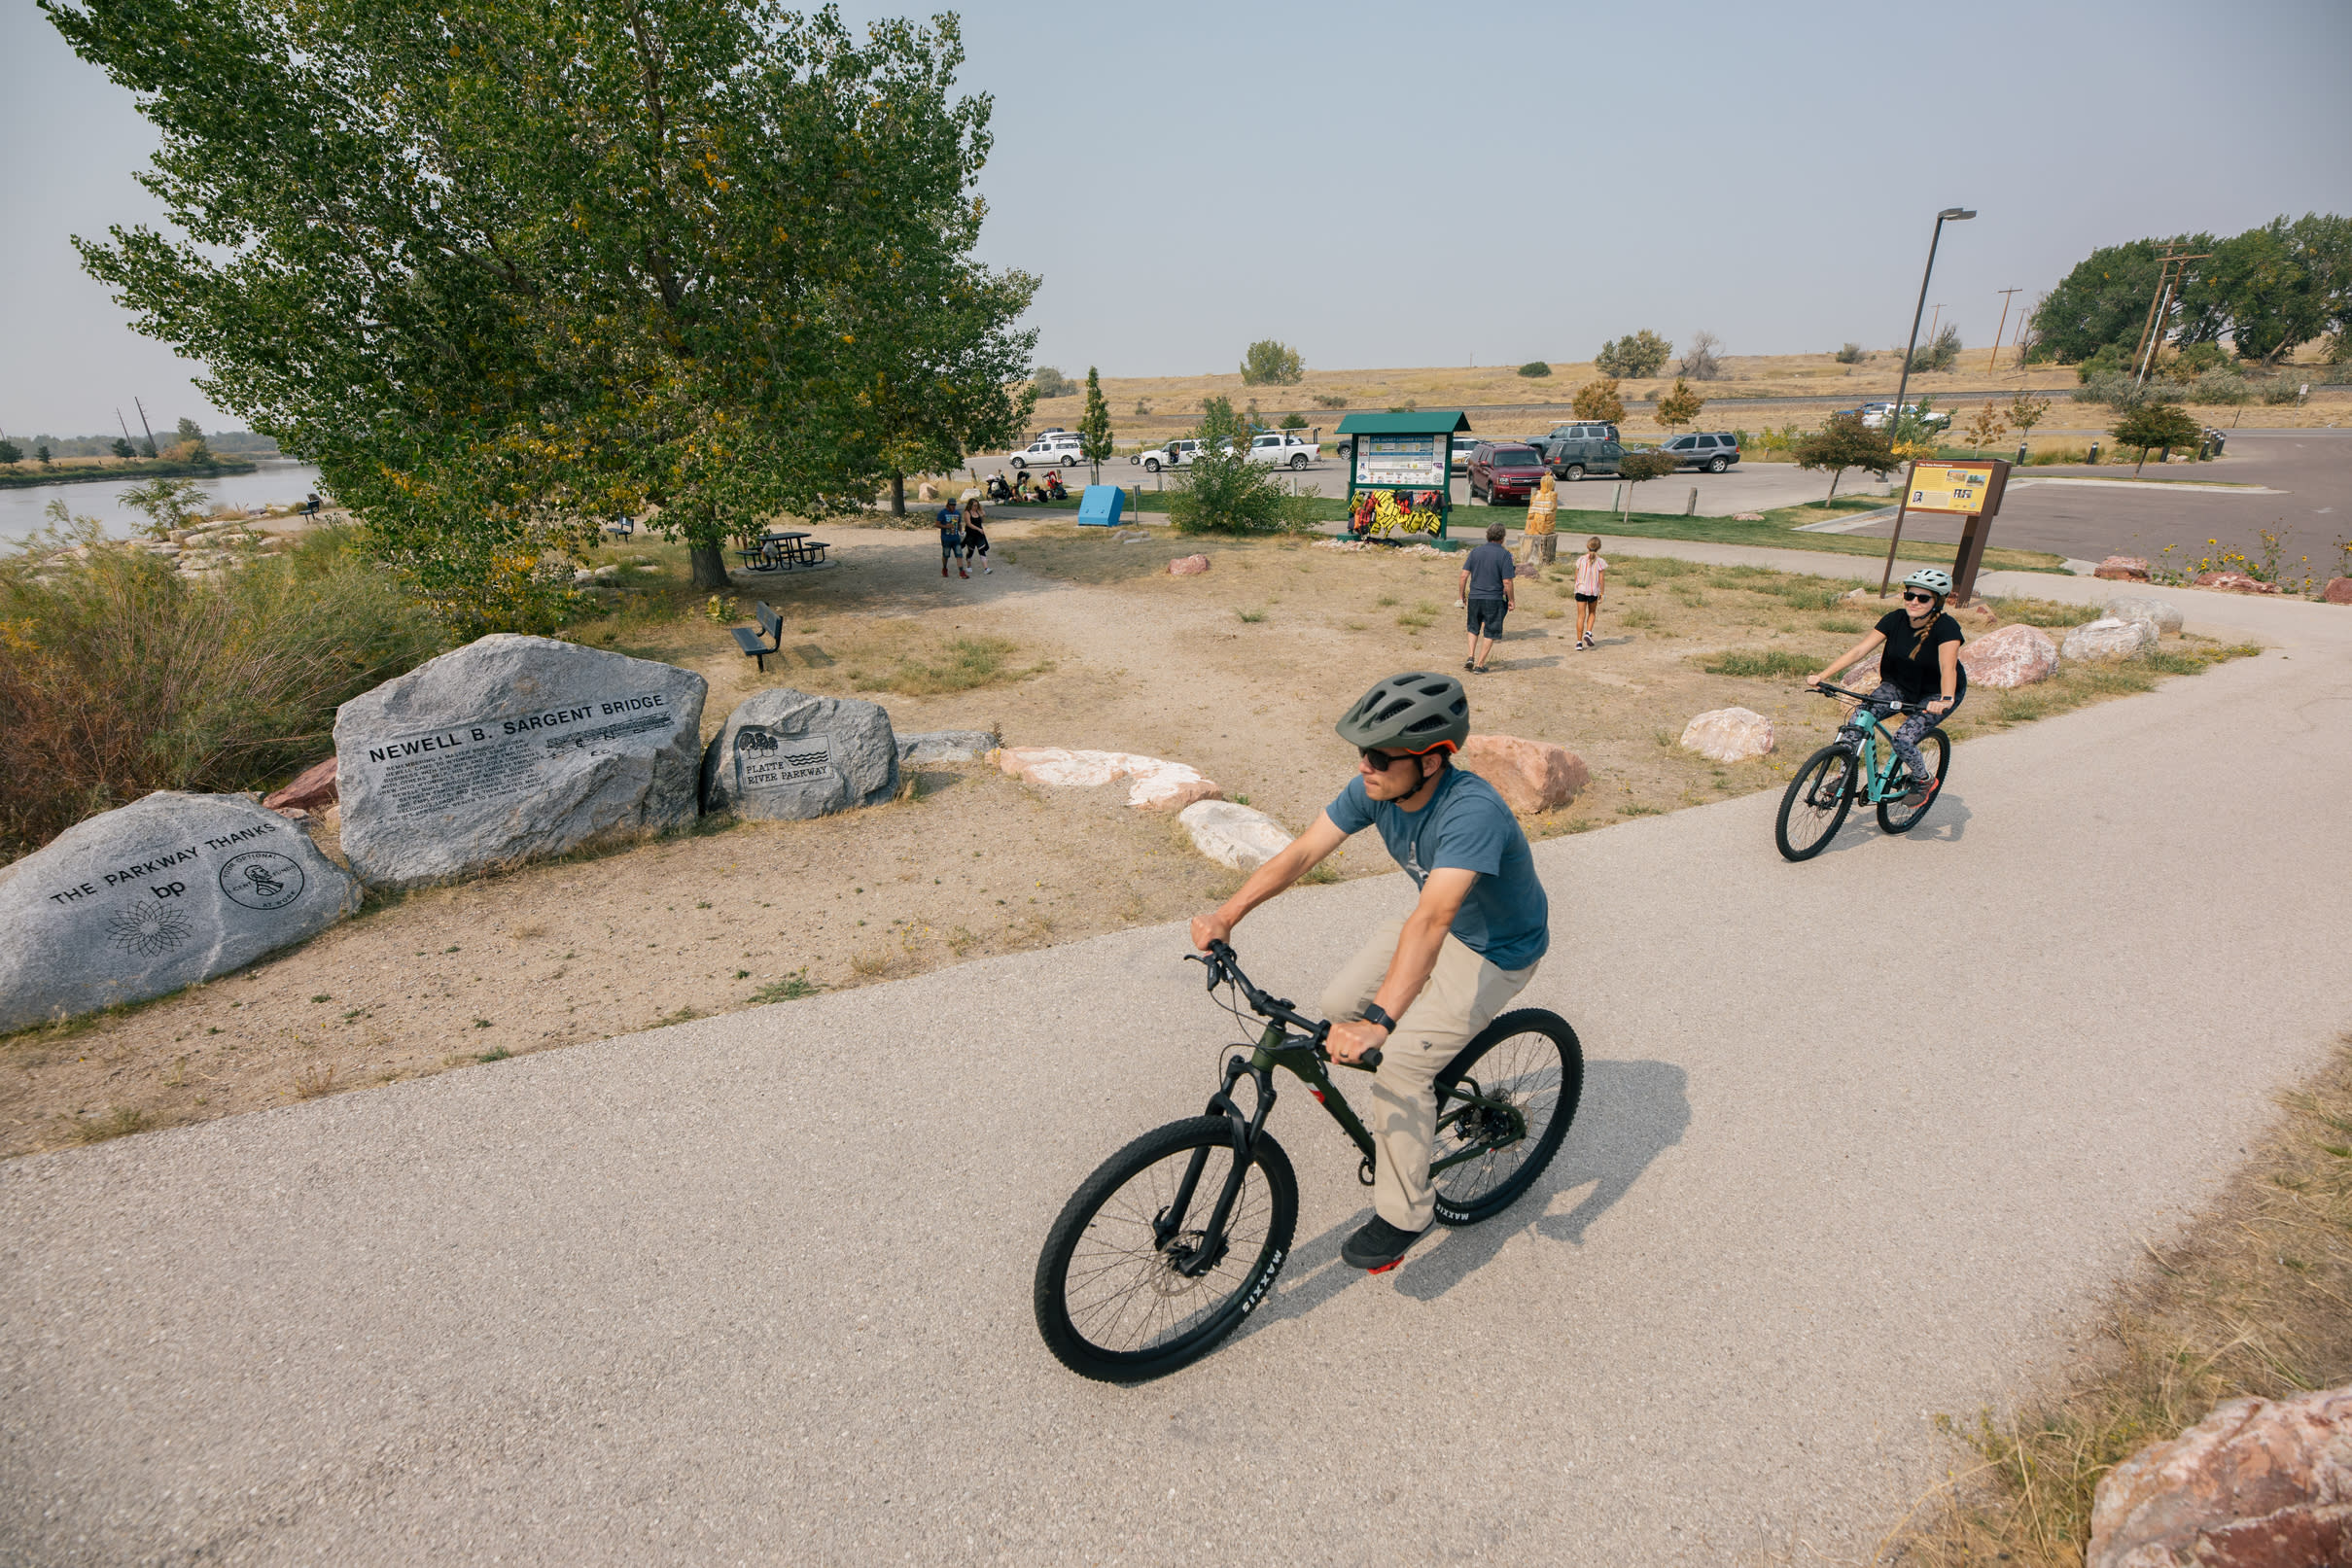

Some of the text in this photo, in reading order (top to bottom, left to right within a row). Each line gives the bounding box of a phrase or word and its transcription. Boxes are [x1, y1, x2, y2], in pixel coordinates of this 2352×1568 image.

[369, 695, 665, 763] NEWELL B. SARGENT BRIDGE
[746, 761, 785, 774] PLATTE
[748, 766, 827, 784] RIVER PARKWAY
[50, 823, 277, 905] THE PARKWAY THANKS
[224, 854, 278, 878] YOUR OPTIONAL
[151, 881, 186, 900] bp
[1436, 1203, 1469, 1221] MAXXIS
[1242, 1249, 1282, 1313] MAXXIS
